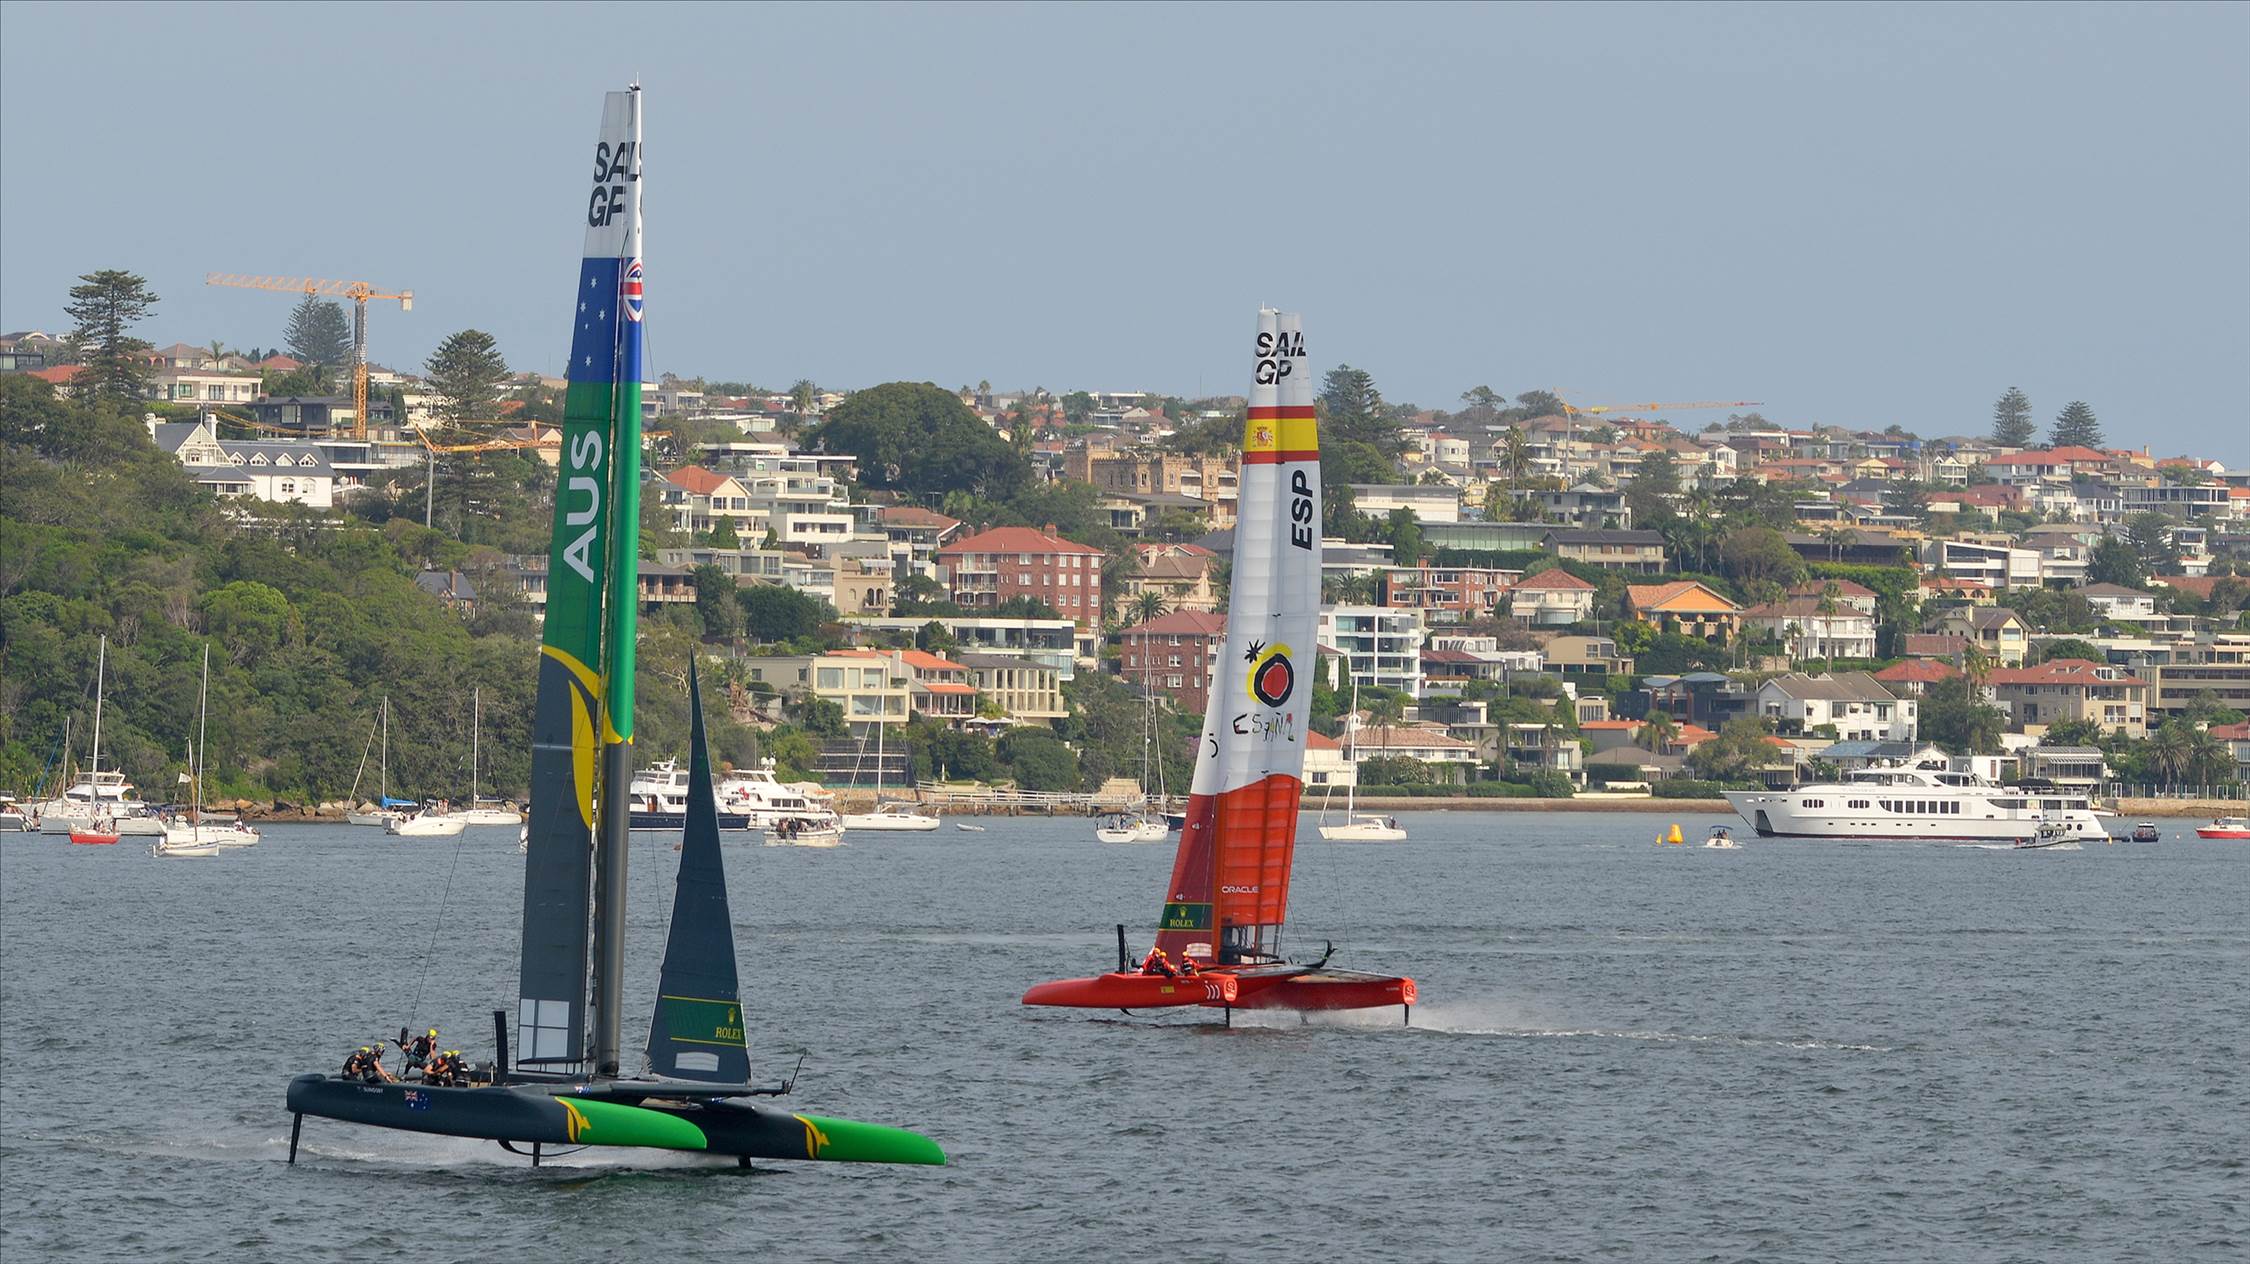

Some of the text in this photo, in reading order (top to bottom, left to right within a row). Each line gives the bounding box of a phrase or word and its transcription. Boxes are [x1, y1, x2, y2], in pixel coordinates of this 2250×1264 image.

[1255, 332, 1306, 357] SAIL
[1255, 360, 1292, 384] GP
[563, 430, 603, 583] AUS
[1291, 469, 1313, 551] ESP
[1221, 886, 1259, 894] ORACLE
[1169, 919, 1194, 928] ROLEX
